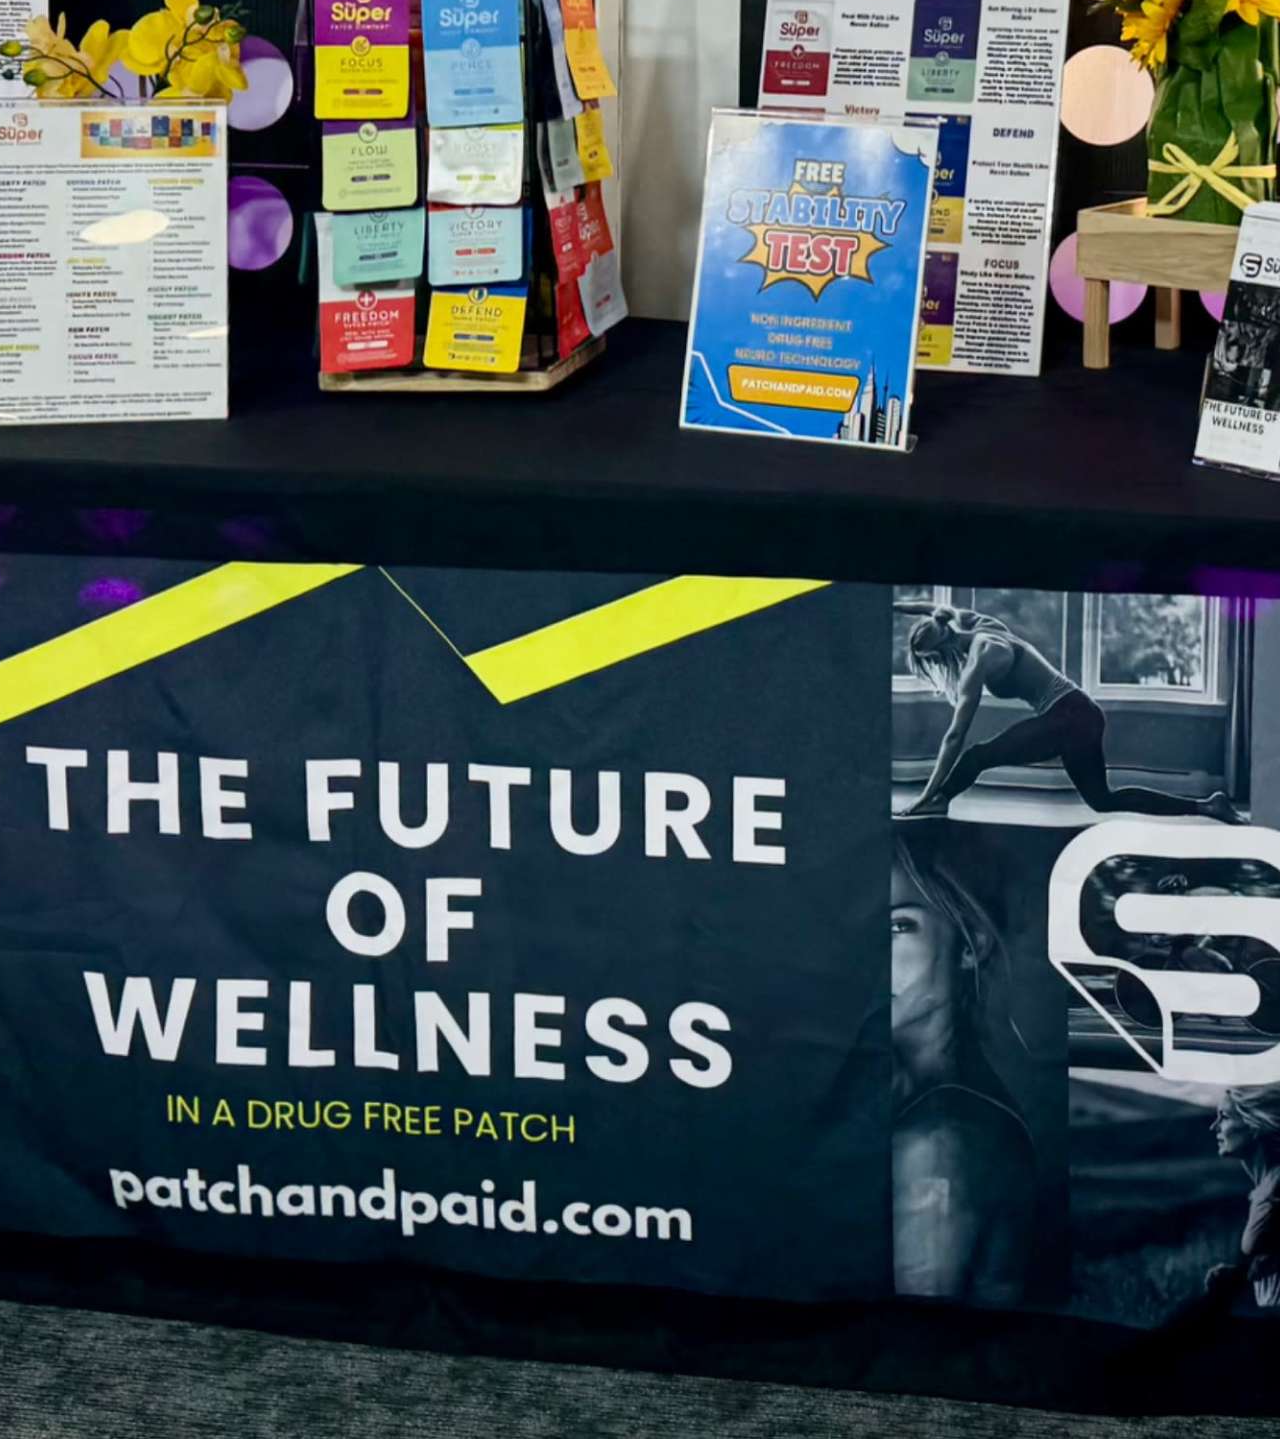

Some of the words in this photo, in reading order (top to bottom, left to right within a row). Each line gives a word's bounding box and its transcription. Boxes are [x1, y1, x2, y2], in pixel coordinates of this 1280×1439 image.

[340, 58, 384, 68] FOCUS
[993, 128, 1034, 138] DEFEND
[794, 159, 846, 184] FREE
[727, 188, 907, 235] STABILITY
[354, 222, 405, 236] LIBERTY
[450, 220, 504, 232] VICTORY
[765, 231, 859, 276] TEST
[984, 259, 1020, 269] FOCUS
[334, 310, 400, 323] FREEDOM
[451, 306, 504, 317] DEFEND
[741, 378, 852, 399] PATCHANDPAID.COM
[1204, 400, 1221, 413] THE
[1223, 404, 1263, 420] FUTURE
[1265, 411, 1279, 423] OF
[1211, 416, 1265, 435] WELLNESS
[24, 745, 254, 840] THE
[305, 758, 787, 866] FUTURE
[325, 870, 483, 963] OF
[82, 971, 735, 1090] WELLNESS
[165, 1094, 201, 1124] IN
[212, 1097, 237, 1128] A
[247, 1099, 352, 1131] DRUG
[364, 1101, 443, 1135] FREE
[453, 1108, 577, 1144] PATCH
[108, 1163, 694, 1242] patchandpaid.com
